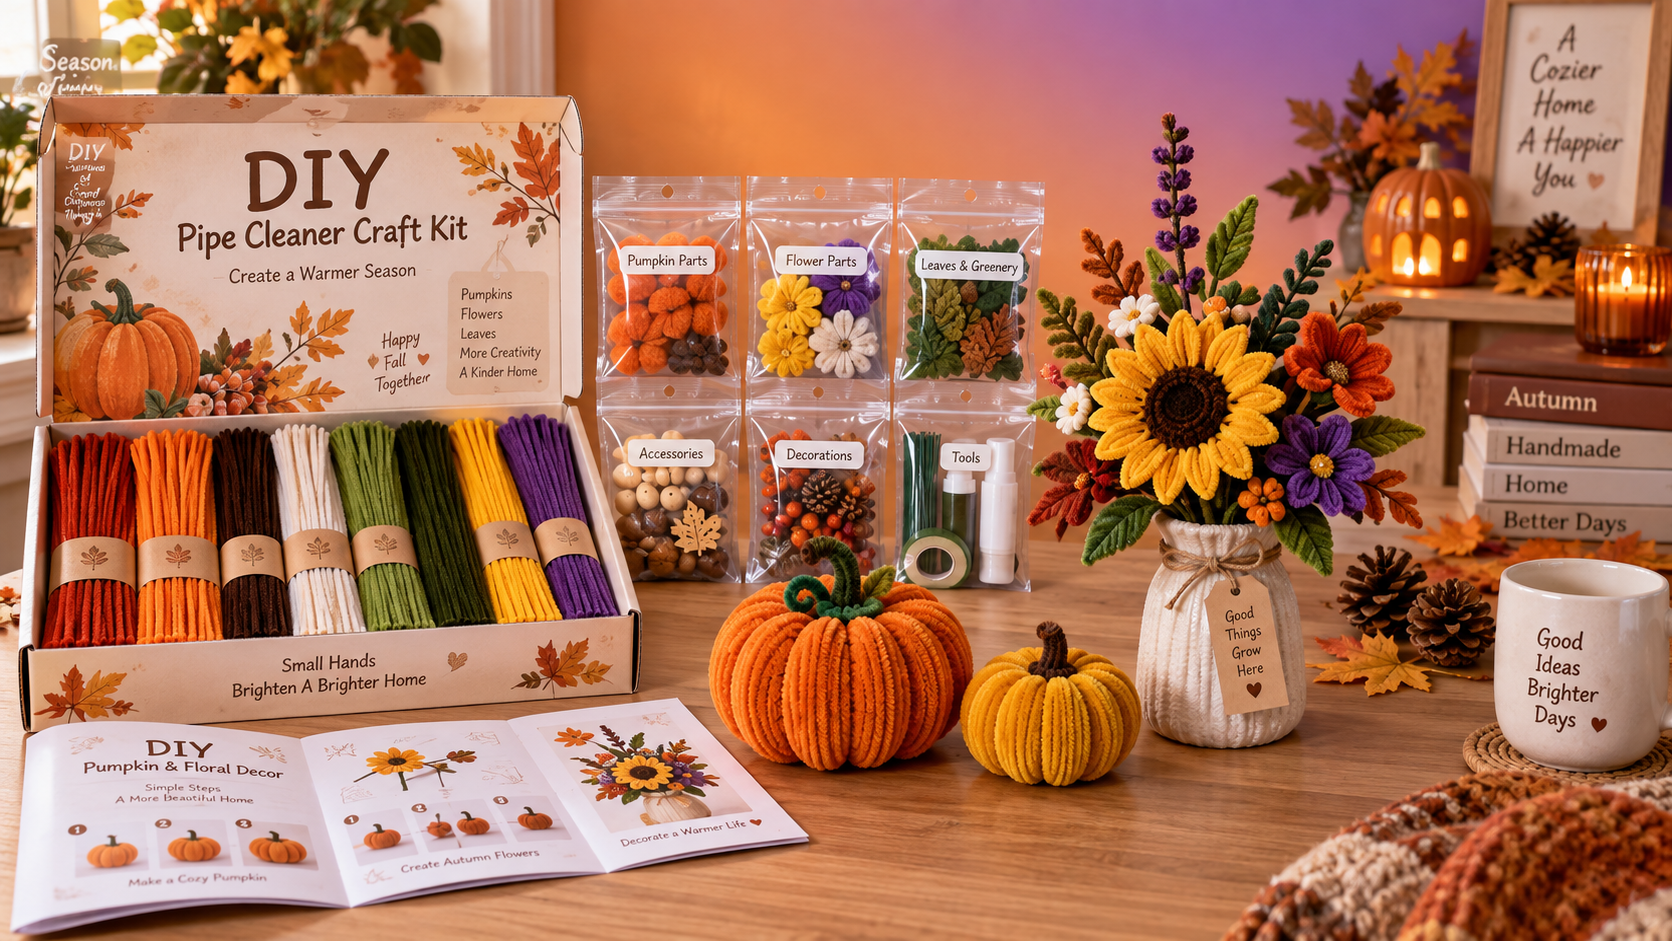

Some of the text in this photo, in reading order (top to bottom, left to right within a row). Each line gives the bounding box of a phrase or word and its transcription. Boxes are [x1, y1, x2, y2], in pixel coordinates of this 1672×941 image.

[1558, 25, 1575, 52] A
[1530, 53, 1602, 83] Cozier
[1534, 88, 1594, 118] Home
[69, 143, 106, 160] DIY
[1518, 126, 1623, 162] A Happier
[245, 148, 389, 212] DIY
[1532, 161, 1575, 197] You
[178, 215, 467, 260] Pipe Cleaner Craft Kit
[627, 253, 708, 270] Pumpkin Parts
[786, 253, 857, 268] Flower Parts
[921, 257, 1019, 277] Leaves & Greenery
[229, 263, 416, 284] Create a Warmer Season
[461, 287, 513, 304] Pumpkins
[460, 307, 503, 320] Flowers
[381, 330, 421, 351] Happy
[460, 327, 497, 340] Leaves
[383, 352, 407, 371] Fall
[459, 346, 542, 362] More Creativity
[459, 365, 538, 379] A Kinder Home
[374, 371, 431, 396] Together
[1505, 387, 1596, 412] Autumn
[638, 446, 704, 460] Accessories
[786, 447, 853, 462] Decorations
[951, 450, 981, 464] Tools
[1506, 435, 1621, 459] Handmade
[1505, 473, 1568, 495] Home
[1503, 510, 1627, 538] Better Days
[1225, 605, 1255, 623] Good
[1224, 627, 1262, 642] Things
[1537, 627, 1584, 651] Good
[281, 652, 376, 673] Small Hands
[1231, 645, 1262, 660] Grow
[1236, 663, 1264, 678] Here
[1535, 653, 1581, 677] Ideas
[232, 673, 427, 702] Brighten A Brighter Home
[1528, 678, 1599, 704] Brighter
[1535, 705, 1575, 733] Days
[146, 740, 213, 758] DIY
[84, 760, 283, 778] Pumpkin & Floral Decor
[145, 783, 221, 795] Simple Steps
[114, 795, 125, 804] A
[129, 795, 159, 803] More
[220, 795, 254, 804] Home
[620, 833, 669, 847] Decorate
[681, 824, 723, 836] Warmer
[725, 820, 747, 830] Life
[400, 850, 540, 873] Create Autumn Flowers
[128, 876, 162, 887] Make
[177, 874, 209, 885] Cozy
[213, 872, 268, 884] Pumpkin
